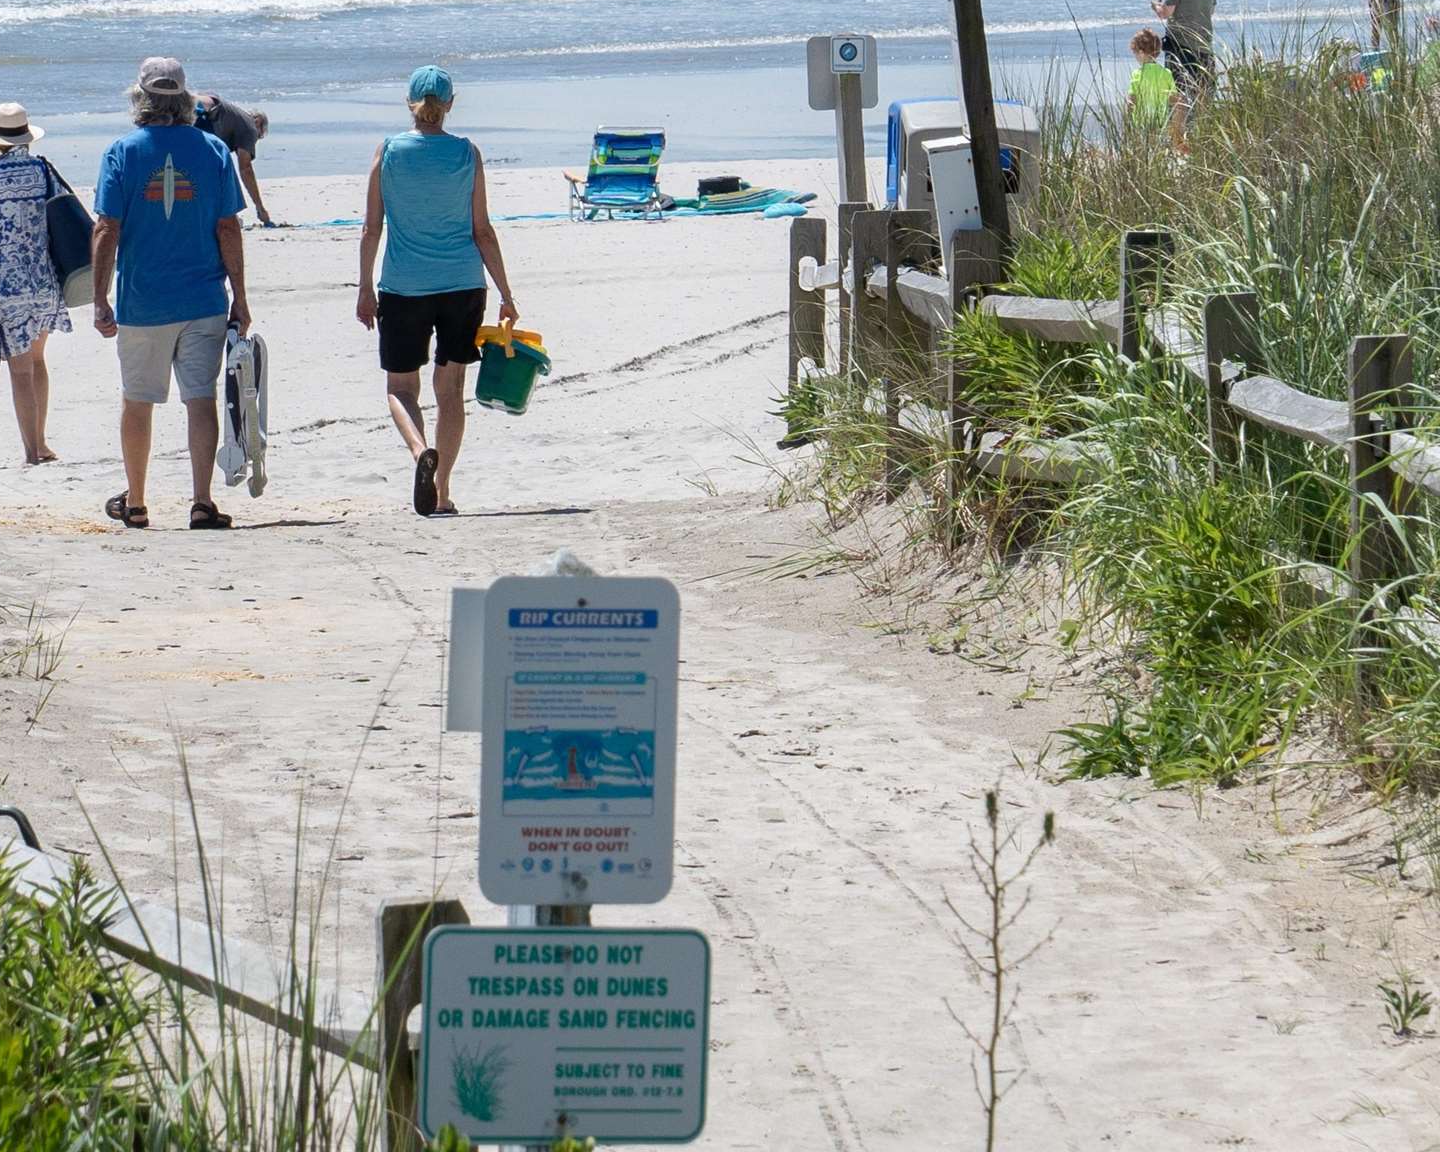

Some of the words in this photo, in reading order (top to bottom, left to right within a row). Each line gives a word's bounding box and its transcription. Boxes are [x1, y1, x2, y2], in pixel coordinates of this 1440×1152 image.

[520, 612, 548, 625] RIP
[552, 612, 644, 625] CURRENTS
[521, 826, 562, 837] WHEN
[566, 827, 580, 837] IN
[584, 827, 630, 837] DOUBT
[528, 841, 568, 852] DON'T
[573, 842, 592, 852] GO
[596, 842, 629, 852] OUT!
[494, 945, 564, 964] PLEASE
[572, 945, 598, 964] DO
[607, 945, 643, 964] NOT
[468, 977, 564, 996] TRESPASS
[573, 977, 598, 996] ON
[607, 977, 668, 996] DUNES
[438, 1008, 463, 1028] OR
[472, 1008, 550, 1028] DAMAGE
[558, 1008, 607, 1028] SAND
[616, 1009, 695, 1028] FENCING
[555, 1064, 620, 1078] SUBJECT
[627, 1064, 645, 1078] TO
[652, 1064, 683, 1078] FINE
[554, 1087, 607, 1096] BOROUGH
